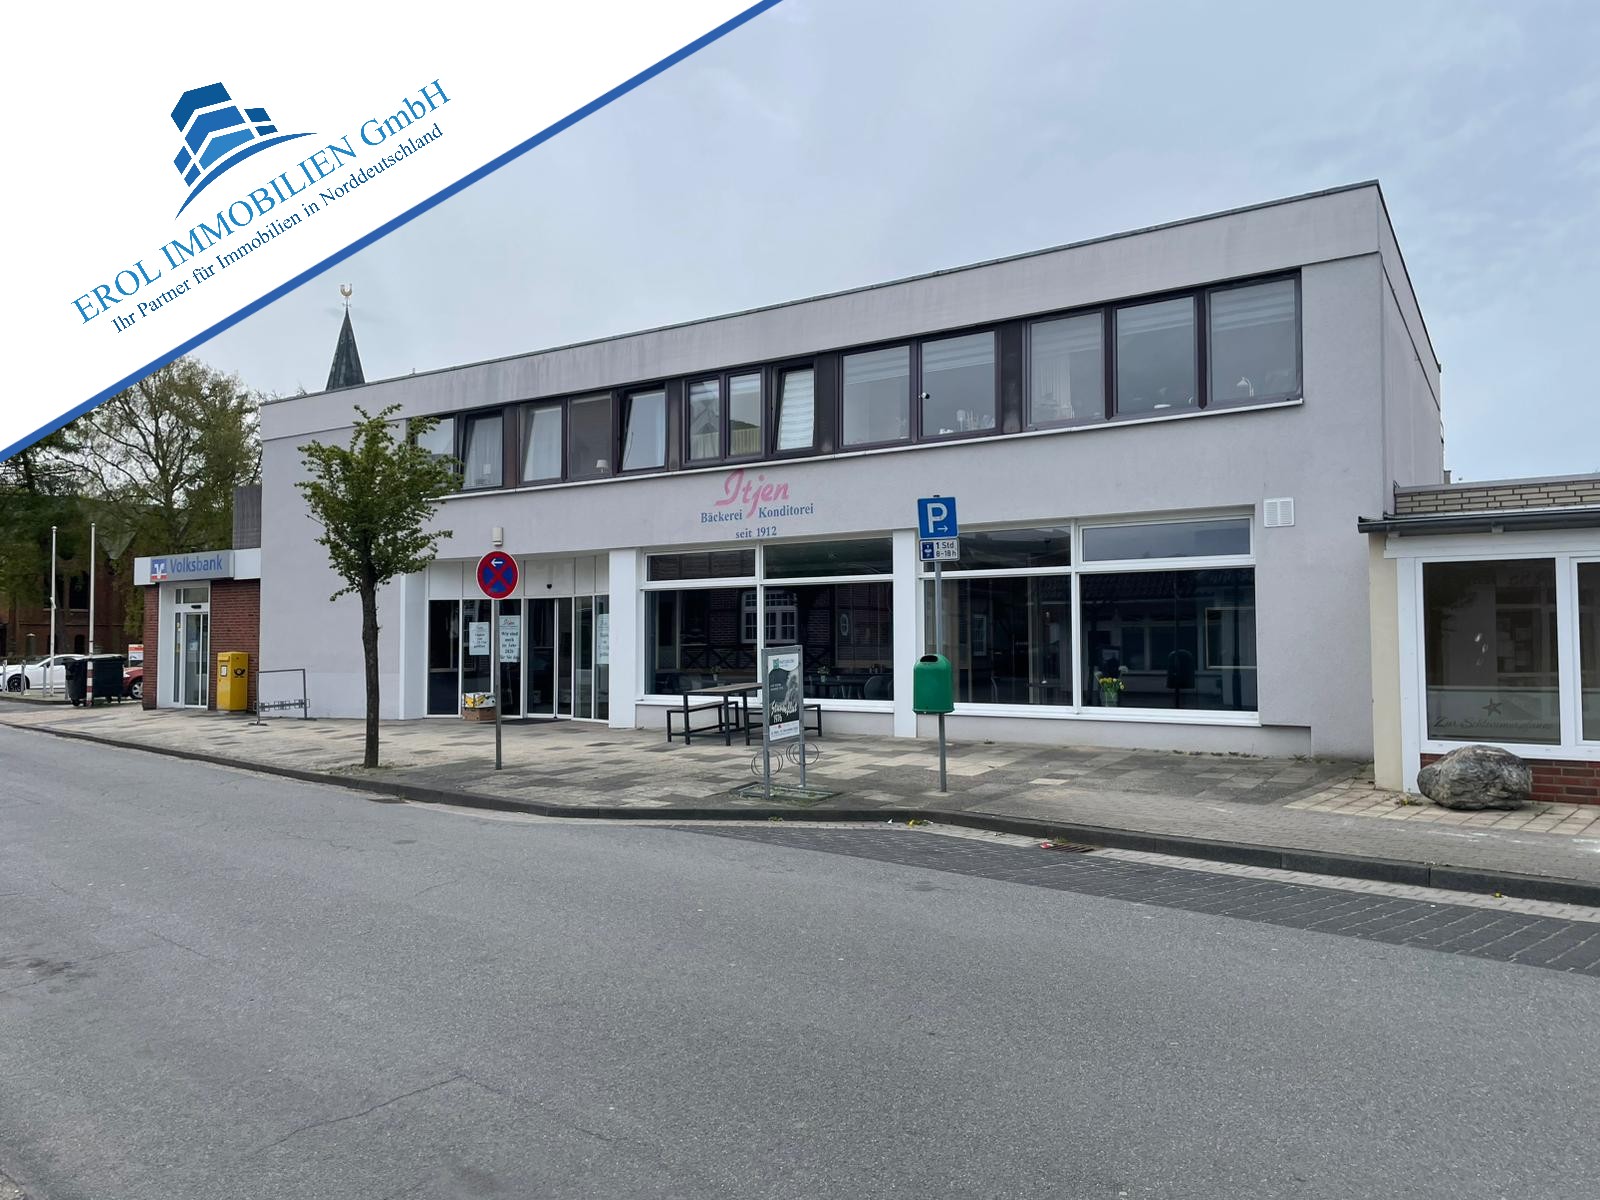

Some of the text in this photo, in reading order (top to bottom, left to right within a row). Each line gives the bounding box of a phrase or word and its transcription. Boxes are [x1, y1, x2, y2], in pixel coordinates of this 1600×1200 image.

[714, 468, 789, 519] Itjen
[700, 503, 814, 523] Bäckerei Konditorei
[927, 503, 948, 533] P
[735, 525, 777, 539] seit 1912
[170, 555, 223, 574] Volksbank
